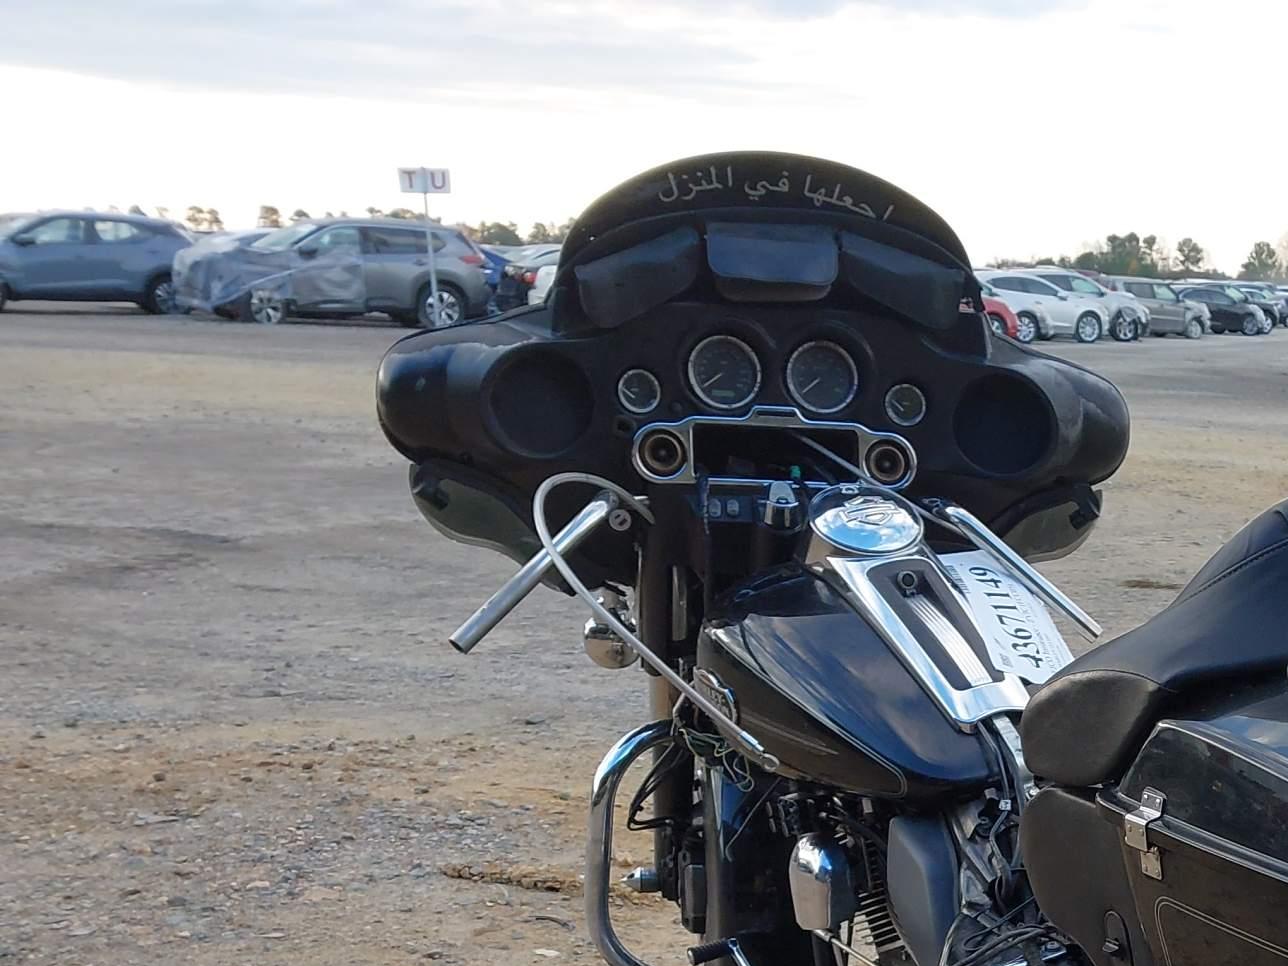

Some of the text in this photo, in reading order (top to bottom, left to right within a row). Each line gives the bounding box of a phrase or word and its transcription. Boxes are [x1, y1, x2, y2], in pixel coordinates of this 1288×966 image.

[402, 171, 446, 190] T U
[658, 165, 733, 202] المنزل
[744, 170, 789, 201] في
[968, 566, 1044, 669] 43671149
